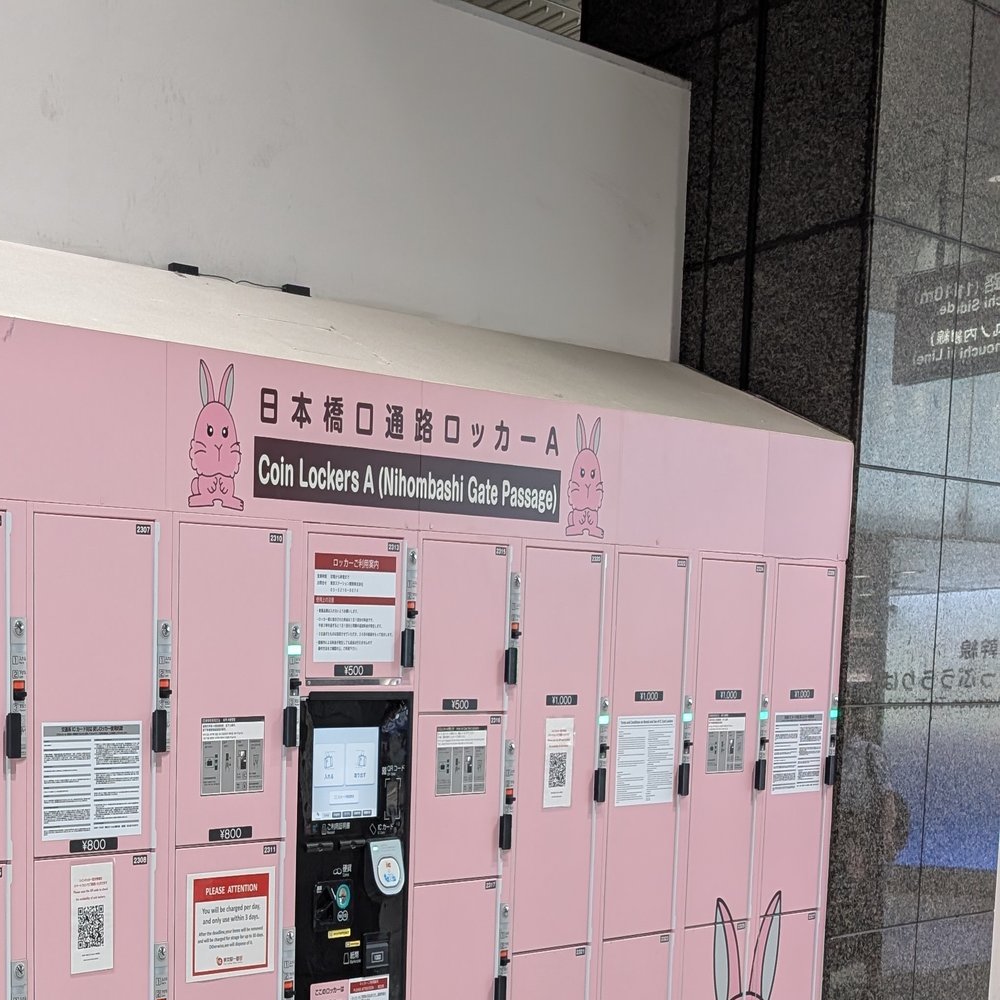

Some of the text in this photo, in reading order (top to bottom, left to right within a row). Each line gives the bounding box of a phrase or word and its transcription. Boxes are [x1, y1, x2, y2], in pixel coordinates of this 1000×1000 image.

[258, 453, 557, 515] Coin Lockers A (Nihombashi Gate Passage)
[136, 525, 150, 534] 2307
[269, 533, 283, 542] 2310
[344, 665, 364, 676] ¥500
[451, 699, 469, 710] ¥500
[219, 828, 242, 839] ¥800
[82, 839, 106, 851] ¥800
[263, 845, 276, 854] 2311
[133, 856, 147, 865] 2308
[205, 883, 258, 896] PLEASE ATTENTION
[211, 906, 219, 914] will
[219, 905, 226, 913] be
[225, 904, 244, 913] charged
[243, 904, 251, 912] per
[202, 917, 212, 925] and
[211, 916, 222, 925] only
[230, 914, 245, 922] within
